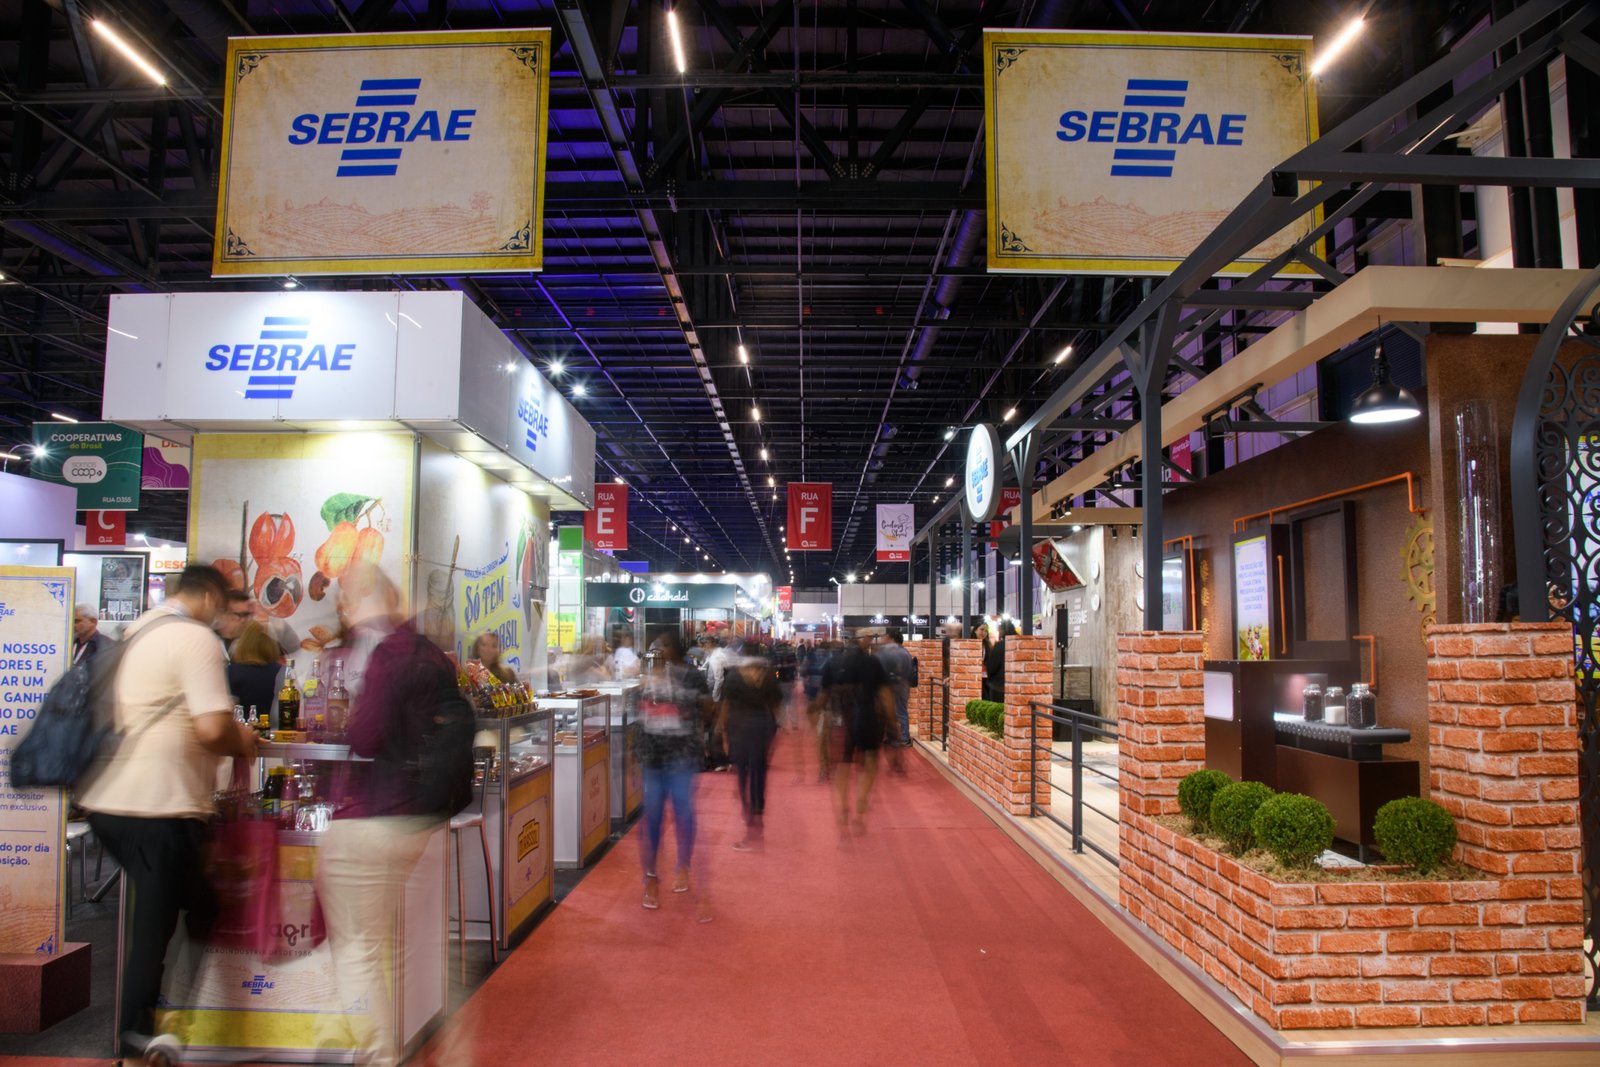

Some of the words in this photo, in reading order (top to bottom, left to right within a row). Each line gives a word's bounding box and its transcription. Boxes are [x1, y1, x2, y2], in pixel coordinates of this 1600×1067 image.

[288, 109, 477, 145] SEBRAE
[1056, 110, 1247, 146] SEBRAE
[205, 344, 357, 371] SEBRAE
[517, 397, 549, 438] SEBRAE
[51, 433, 122, 442] COOPERATIVAS
[598, 492, 615, 501] RUA
[801, 492, 819, 501] RUA
[1003, 490, 1021, 499] RUA
[597, 507, 615, 534] E
[800, 507, 819, 534] F
[482, 575, 505, 617] TEM
[3, 643, 57, 655] NOSSOS
[36, 660, 48, 674] E,
[0, 675, 19, 686] AR
[22, 676, 44, 687] UM
[16, 708, 37, 720] DO
[7, 792, 45, 801] expositor
[15, 844, 33, 853] por
[34, 843, 50, 853] dia
[241, 981, 276, 989] SEBRAE
